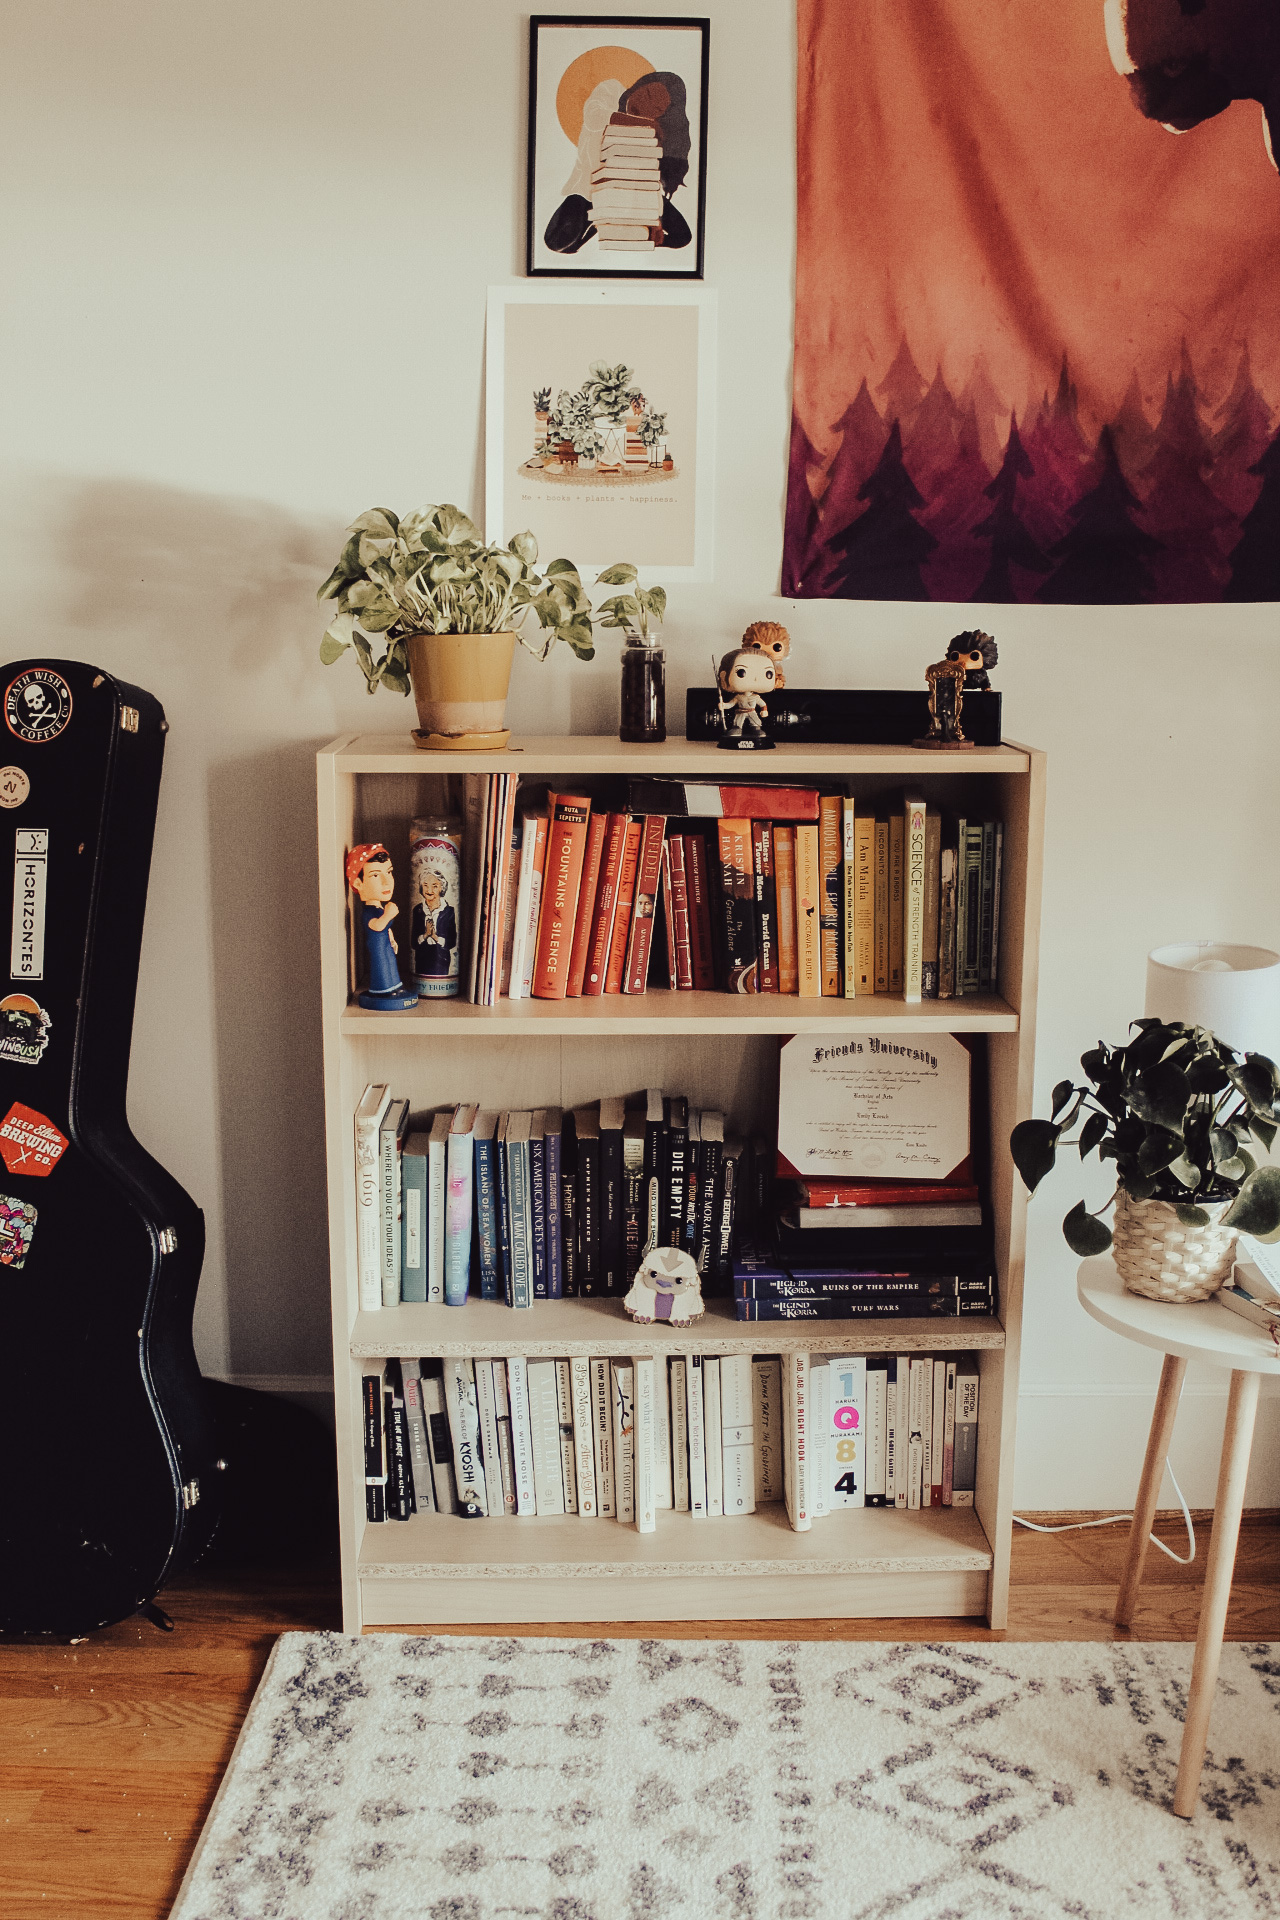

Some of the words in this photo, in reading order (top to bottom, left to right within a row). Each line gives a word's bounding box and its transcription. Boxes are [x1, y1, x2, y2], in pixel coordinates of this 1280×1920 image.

[7, 675, 30, 710] DEATH
[35, 672, 61, 688] WISH
[20, 720, 64, 740] COFFEE
[559, 815, 582, 823] SEPETYS
[613, 825, 621, 834] WE
[822, 808, 837, 847] ANXIOUS
[609, 851, 617, 860] TO
[610, 836, 620, 850] NEED
[625, 833, 639, 855] bell
[643, 824, 662, 882] INFIDEL
[762, 831, 770, 862] Killers
[859, 844, 869, 863] Am
[606, 861, 616, 876] TALK
[722, 836, 733, 886] HANNAH
[734, 835, 745, 885] KRISTIN
[823, 851, 838, 881] PEOPLE
[911, 833, 923, 886] SCIENCE
[554, 837, 573, 908] FOUNTAINS
[621, 859, 636, 893] hooks
[859, 866, 869, 900] Malala
[756, 875, 764, 901] Moon
[21, 864, 37, 972] HORIZONTES
[725, 899, 735, 924] Great
[824, 893, 838, 927] FREDRIK
[911, 897, 920, 940] STRENGTH
[596, 917, 607, 940] CELESTE
[728, 926, 737, 951] Alone
[761, 914, 769, 940] David
[547, 922, 562, 973] SILENCE
[593, 942, 604, 966] HEADLEE
[763, 941, 771, 970] Grann
[824, 931, 838, 973] BACKMAN
[910, 943, 919, 982] TRAINING
[812, 1041, 864, 1064] Friends
[868, 1037, 938, 1070] University
[10, 1117, 34, 1131] DEEP
[0, 1124, 62, 1158] BREWING
[480, 1145, 488, 1161] THE
[533, 1143, 543, 1158] SIX
[384, 1145, 393, 1173] WHERE
[671, 1151, 684, 1172] DIE
[359, 1173, 377, 1207] 1619
[385, 1175, 393, 1186] DO
[533, 1160, 543, 1213] AMERICAN
[385, 1188, 393, 1204] YOU
[481, 1197, 489, 1210] OF
[563, 1184, 572, 1218] HOBBIT
[670, 1178, 683, 1219] EMPTY
[385, 1205, 393, 1220] GET
[385, 1222, 393, 1243] YOUR
[514, 1220, 524, 1239] MAN
[534, 1215, 544, 1242] POETS
[626, 1220, 639, 1242] KITE
[386, 1245, 394, 1274] IDEAS?
[483, 1231, 491, 1265] WOMEN
[514, 1241, 525, 1269] CALLED
[515, 1272, 525, 1288] OVE
[784, 1287, 815, 1296] KORRA
[787, 1308, 818, 1317] KORRA
[575, 1363, 587, 1387] Jojo
[597, 1363, 605, 1381] HOW
[796, 1358, 804, 1374] JAB,
[406, 1378, 418, 1407] Quiet
[540, 1376, 552, 1385] A
[641, 1384, 650, 1399] say
[760, 1374, 770, 1398] DONNA
[796, 1375, 804, 1390] JAB,
[839, 1373, 853, 1397] 1
[964, 1383, 970, 1392] OF
[515, 1386, 523, 1420] DELILLO
[576, 1387, 589, 1427] Moyes
[598, 1397, 606, 1405] IT
[691, 1390, 699, 1421] Writer's
[796, 1391, 804, 1407] JAB,
[541, 1391, 556, 1445] LITTLE
[599, 1406, 607, 1432] BEGIN?
[643, 1402, 652, 1424] what
[761, 1401, 770, 1427] TARTT
[797, 1408, 805, 1435] RIGHT
[833, 1406, 859, 1430] Q
[518, 1431, 526, 1456] WHITE
[643, 1427, 651, 1445] you
[459, 1441, 476, 1483] KYOSHI
[623, 1440, 631, 1461] THE
[798, 1438, 806, 1462] HOOK
[835, 1439, 856, 1463] 8
[545, 1449, 559, 1483] LIFE
[623, 1465, 632, 1503] CHOICE
[834, 1472, 858, 1495] 4
